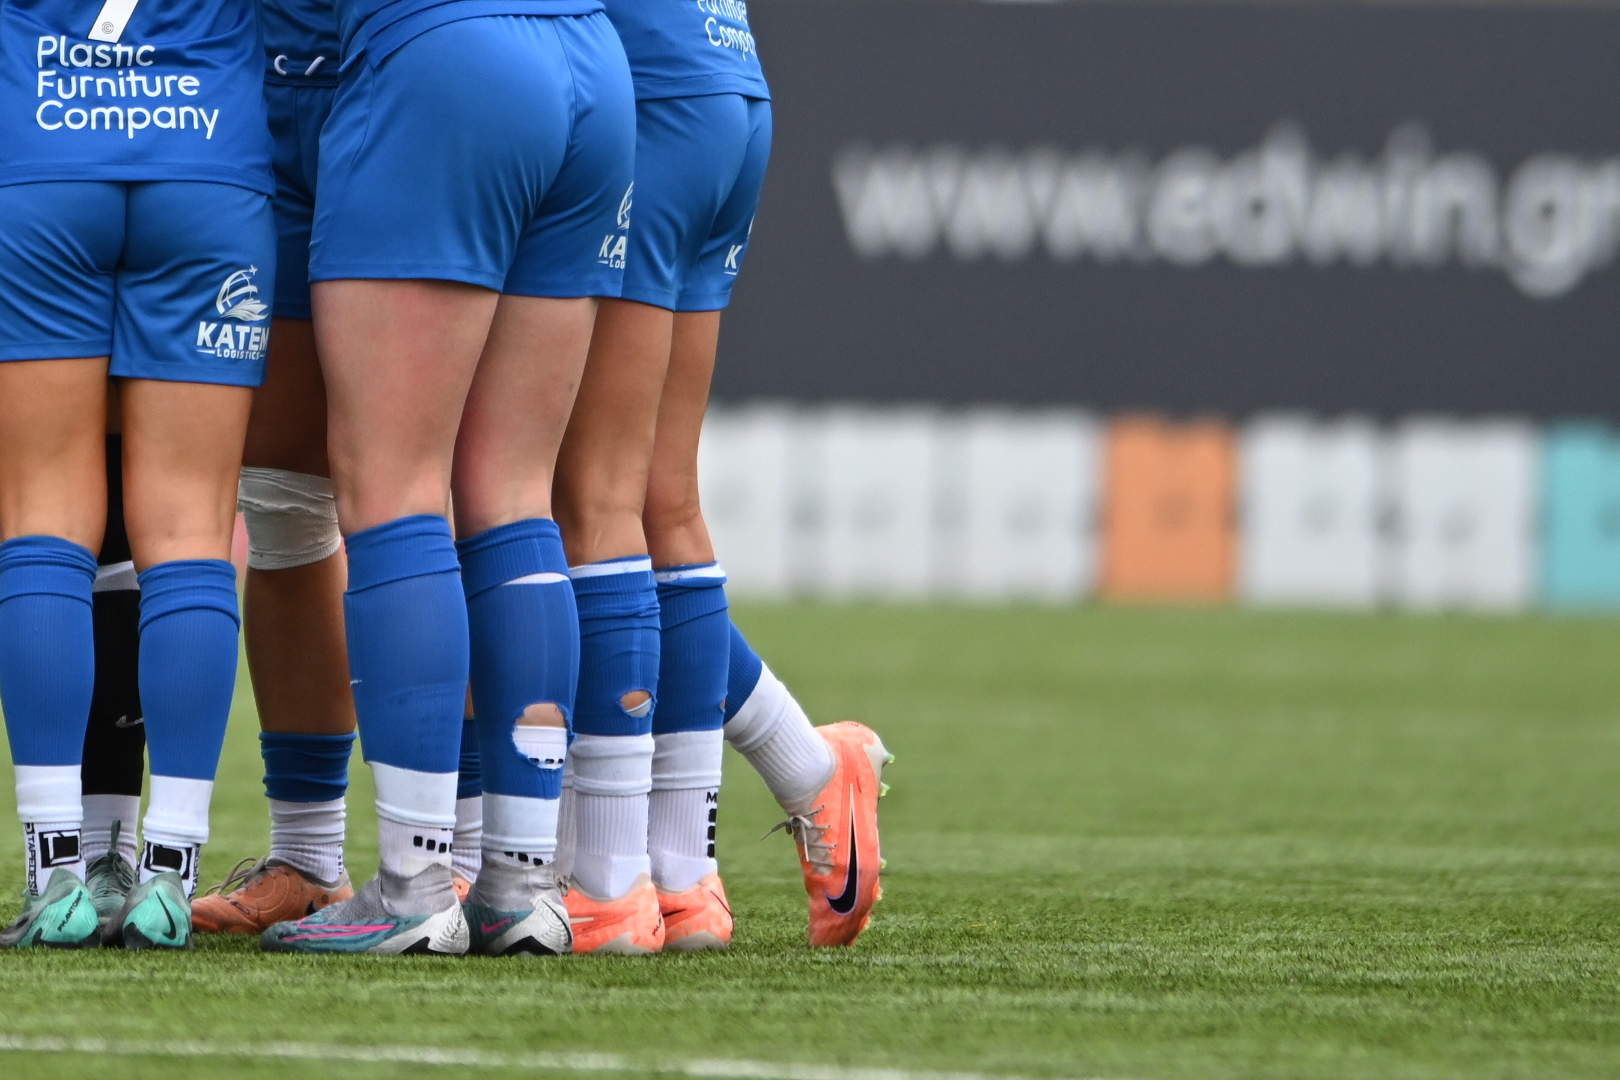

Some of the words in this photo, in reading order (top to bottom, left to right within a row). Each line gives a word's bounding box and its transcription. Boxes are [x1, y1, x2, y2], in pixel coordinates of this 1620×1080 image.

[37, 35, 155, 68] Plastic
[705, 16, 758, 62] Compa
[37, 70, 200, 100] Furniture
[35, 100, 219, 140] Company
[216, 348, 260, 361] LOGISTICS
